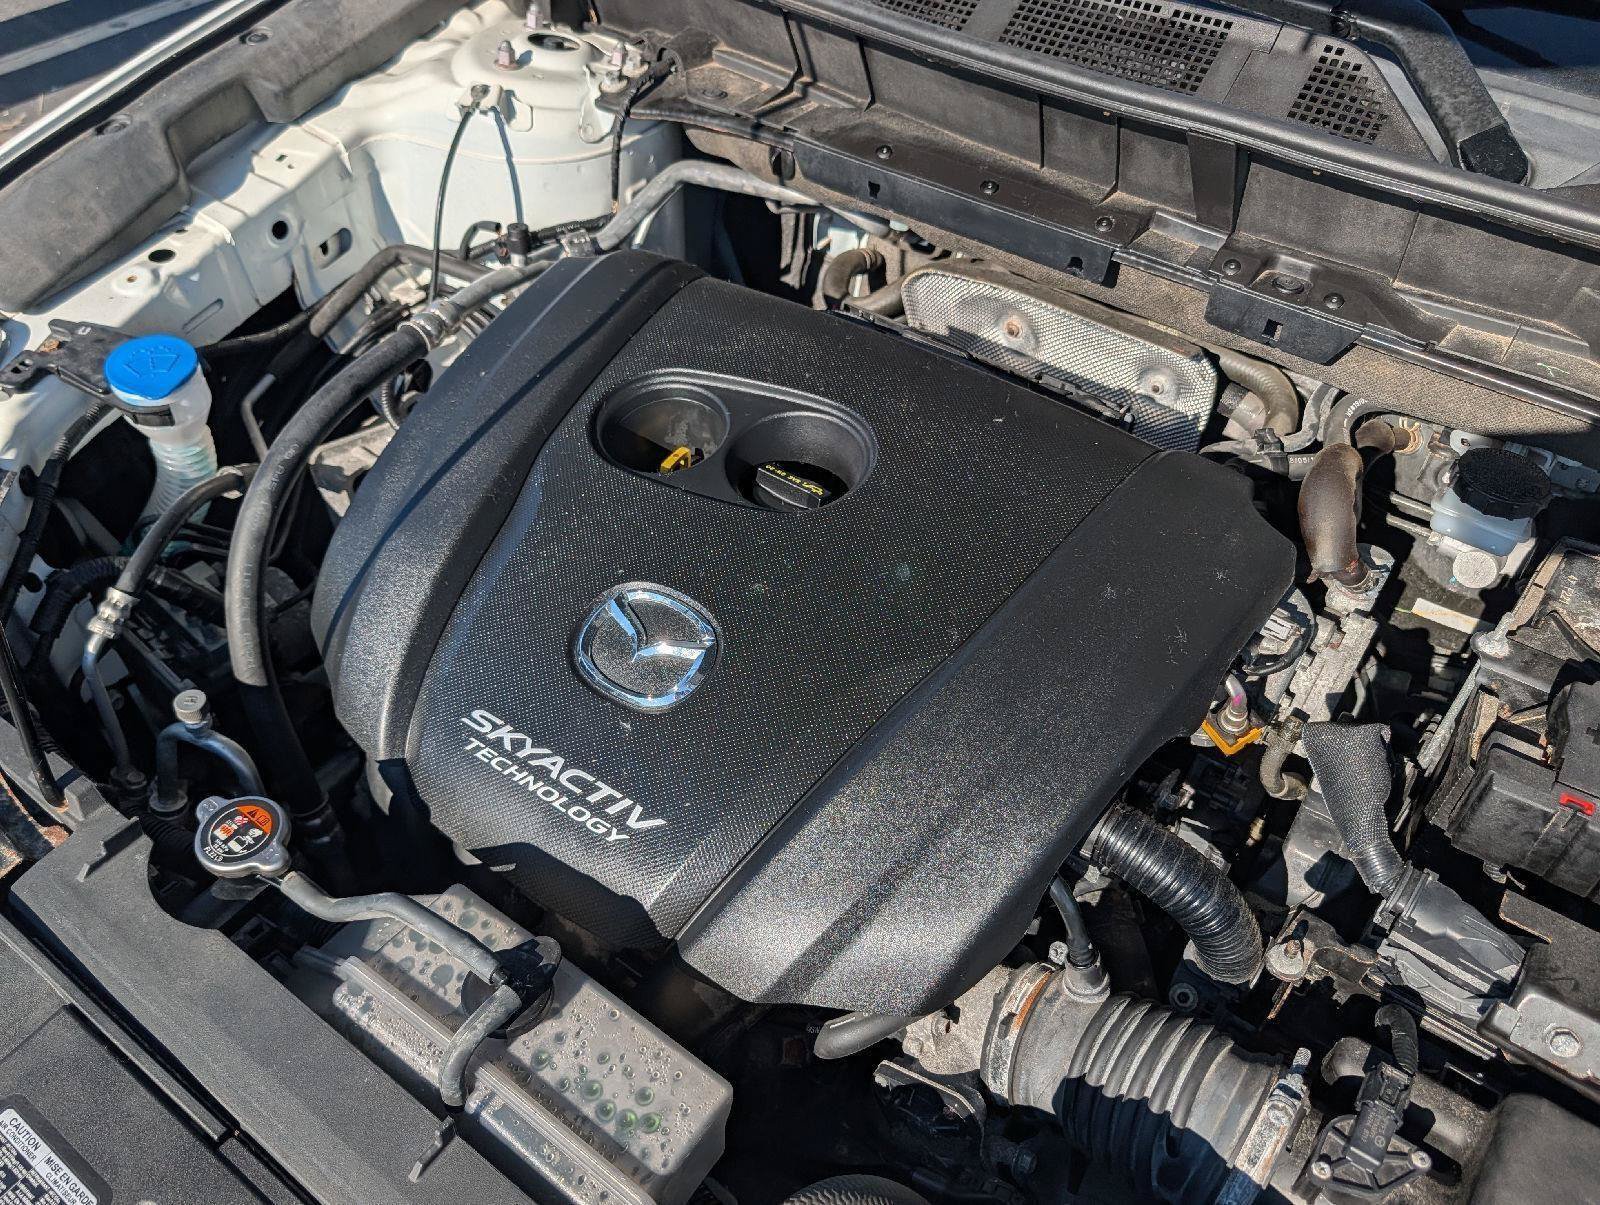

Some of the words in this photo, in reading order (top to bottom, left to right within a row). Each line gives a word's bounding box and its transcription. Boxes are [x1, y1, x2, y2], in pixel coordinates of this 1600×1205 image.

[460, 709, 667, 829] SKYACTIV
[463, 738, 630, 842] TECHNOLOGY
[6, 1127, 37, 1162] CONDITIONER
[9, 1117, 42, 1152] CAUTION
[44, 1156, 62, 1175] MISE
[59, 1172, 73, 1187] EN
[69, 1182, 95, 1205] GARDE
[45, 1172, 77, 1205] CLIMATISEUR
